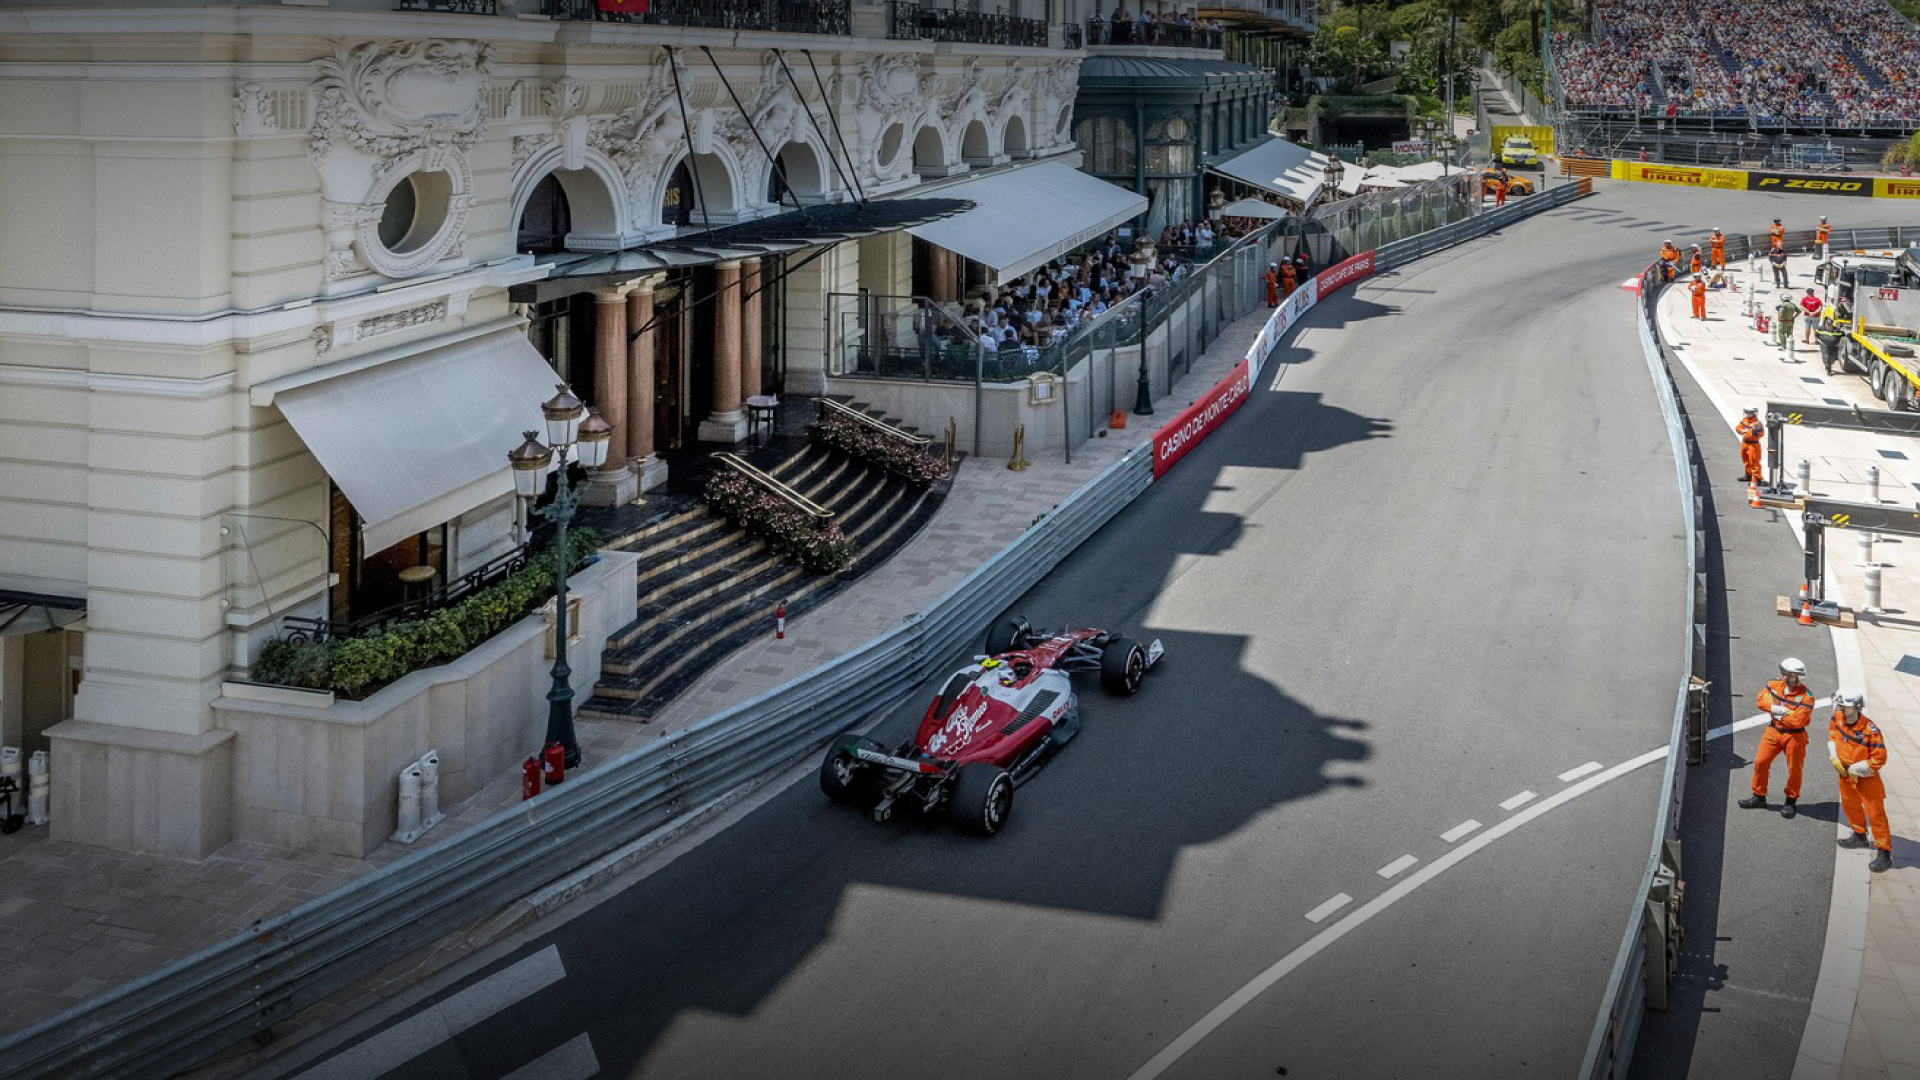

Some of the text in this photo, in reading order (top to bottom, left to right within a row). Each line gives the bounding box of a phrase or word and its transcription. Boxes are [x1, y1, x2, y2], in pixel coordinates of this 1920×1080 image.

[1641, 167, 1702, 184] PIRELLI
[1759, 177, 1863, 191] P ZERO
[1320, 274, 1334, 292] CASINO
[1355, 258, 1370, 272] PARIS
[1161, 374, 1248, 460] CASINO DE MONTE-CARLO
